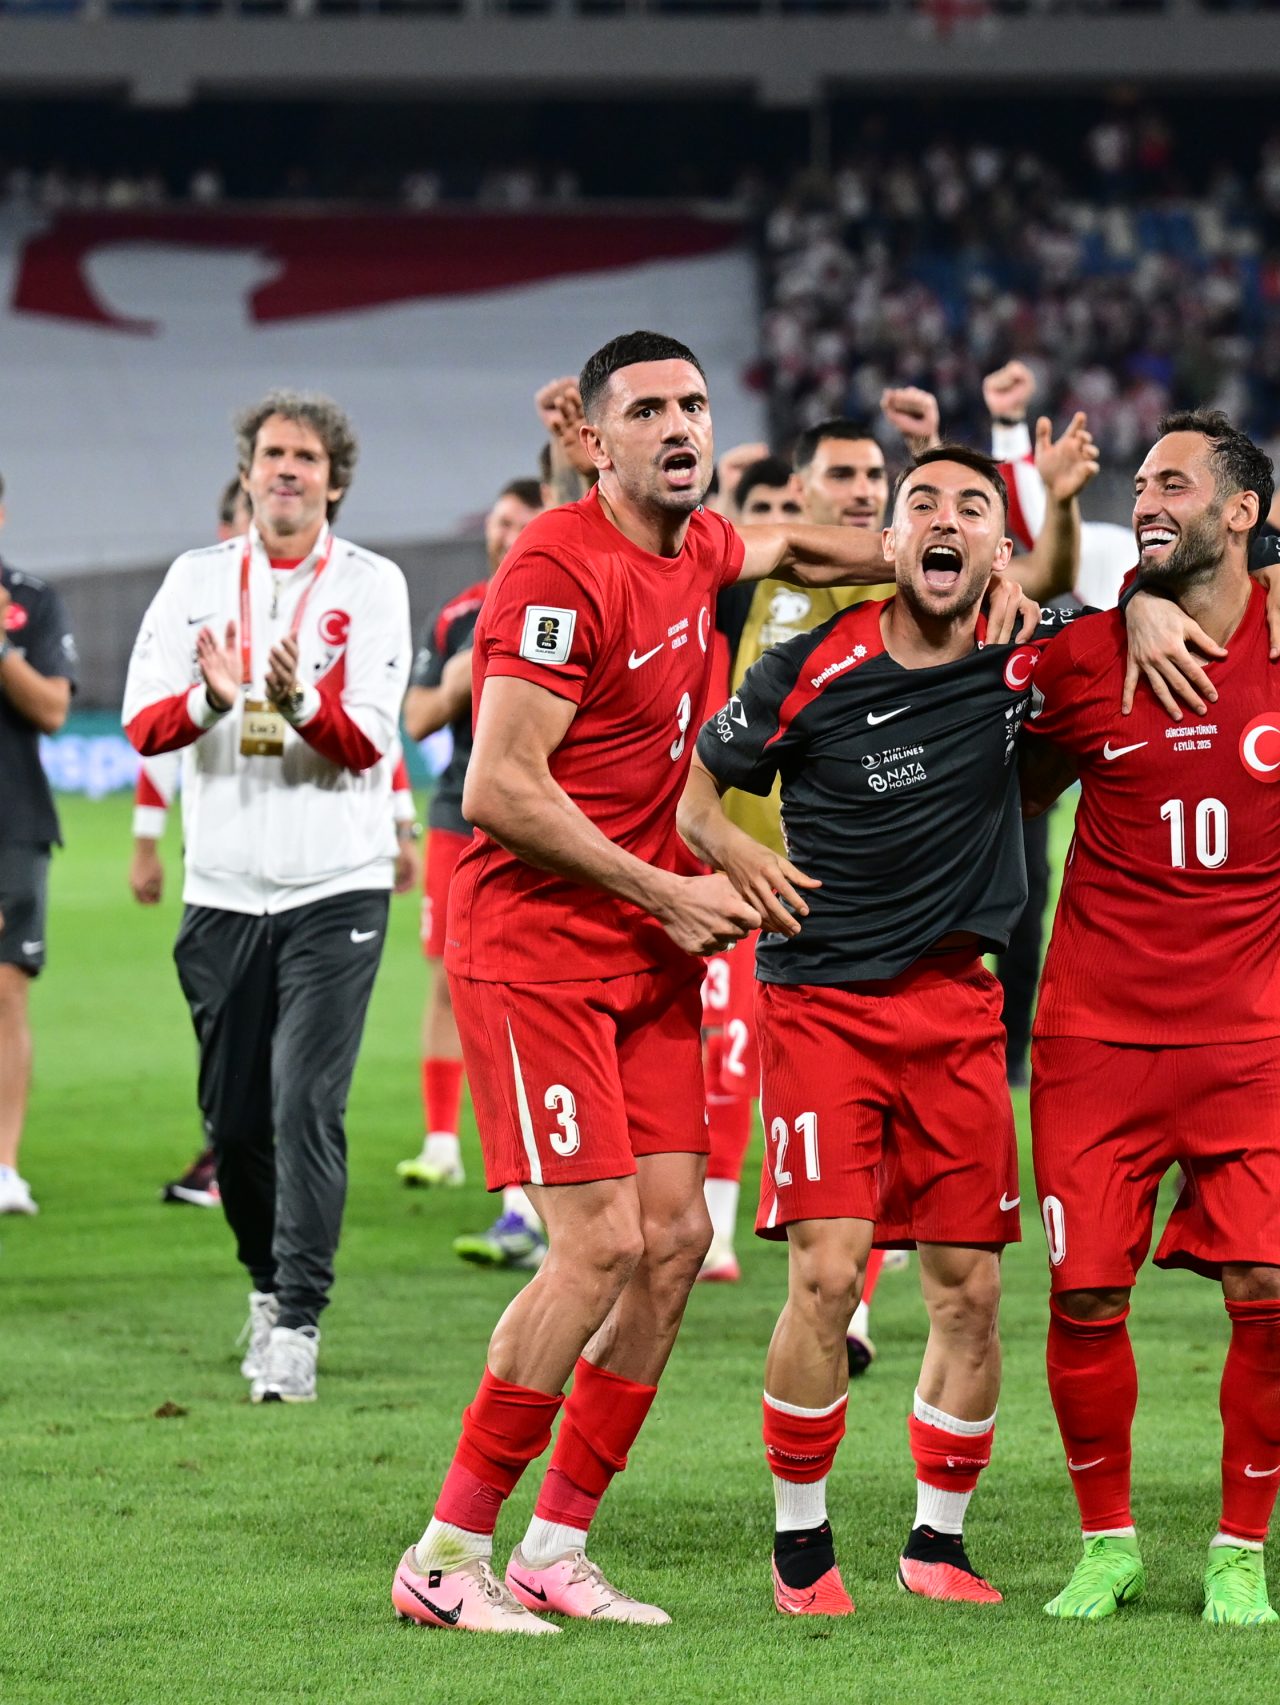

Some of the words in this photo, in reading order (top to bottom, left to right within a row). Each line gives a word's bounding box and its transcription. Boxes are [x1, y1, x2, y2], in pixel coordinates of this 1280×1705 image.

[810, 655, 857, 689] DenizBank
[883, 745, 925, 764] AIRLINES
[1173, 742, 1178, 752] 4
[1178, 740, 1196, 751] EYLÜL
[1196, 740, 1211, 750] 2025
[886, 762, 925, 782] NATA
[889, 772, 927, 789] HOLDING
[1160, 797, 1229, 869] 10
[544, 1085, 581, 1157] 3
[771, 1111, 821, 1188] 21
[1042, 1195, 1067, 1266] 0
